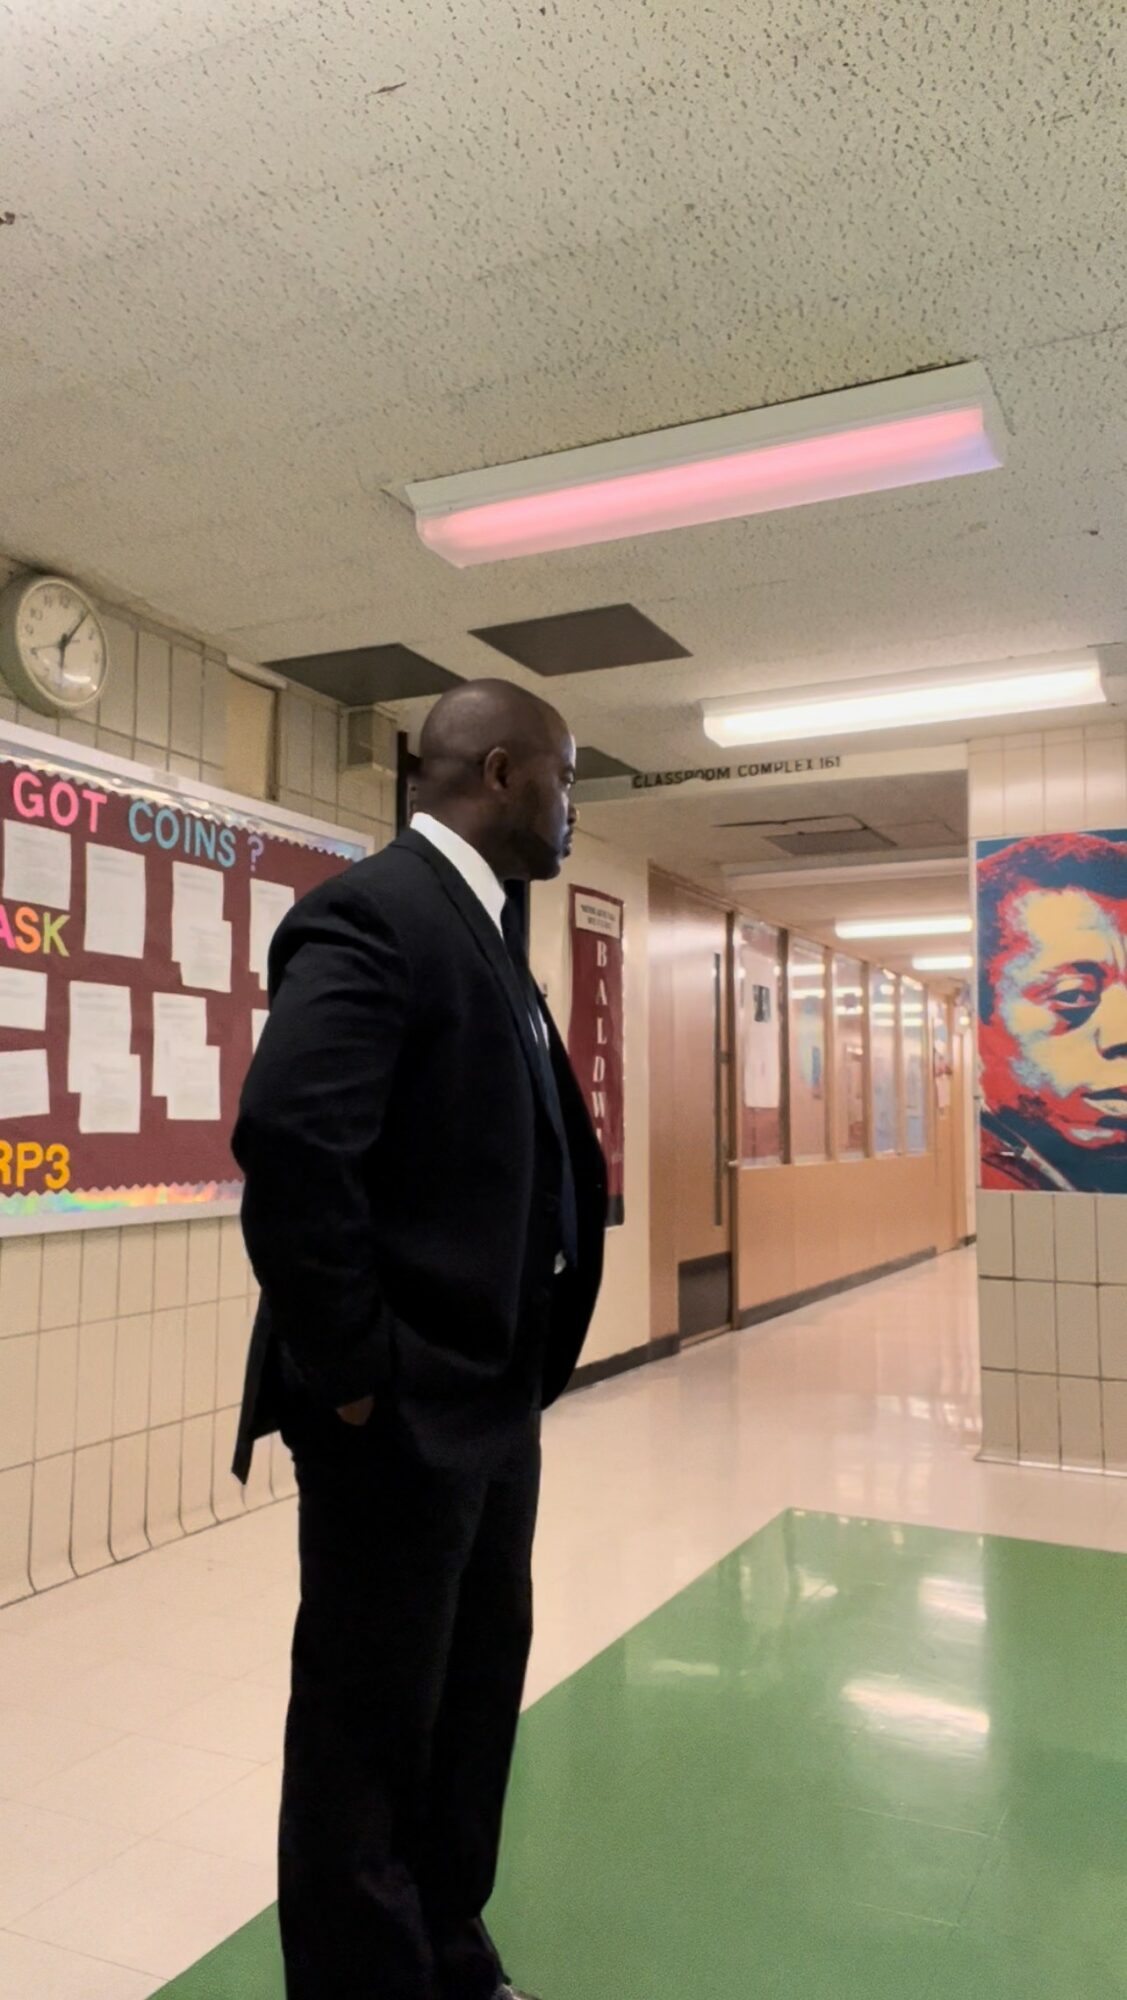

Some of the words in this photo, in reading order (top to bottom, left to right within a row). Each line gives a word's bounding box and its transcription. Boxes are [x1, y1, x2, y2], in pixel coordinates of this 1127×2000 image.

[632, 767, 730, 789] CLASSROOM
[13, 772, 107, 832] GOT
[128, 801, 236, 868] COINS
[0, 904, 71, 957] ASK
[0, 1139, 70, 1190] RP3
